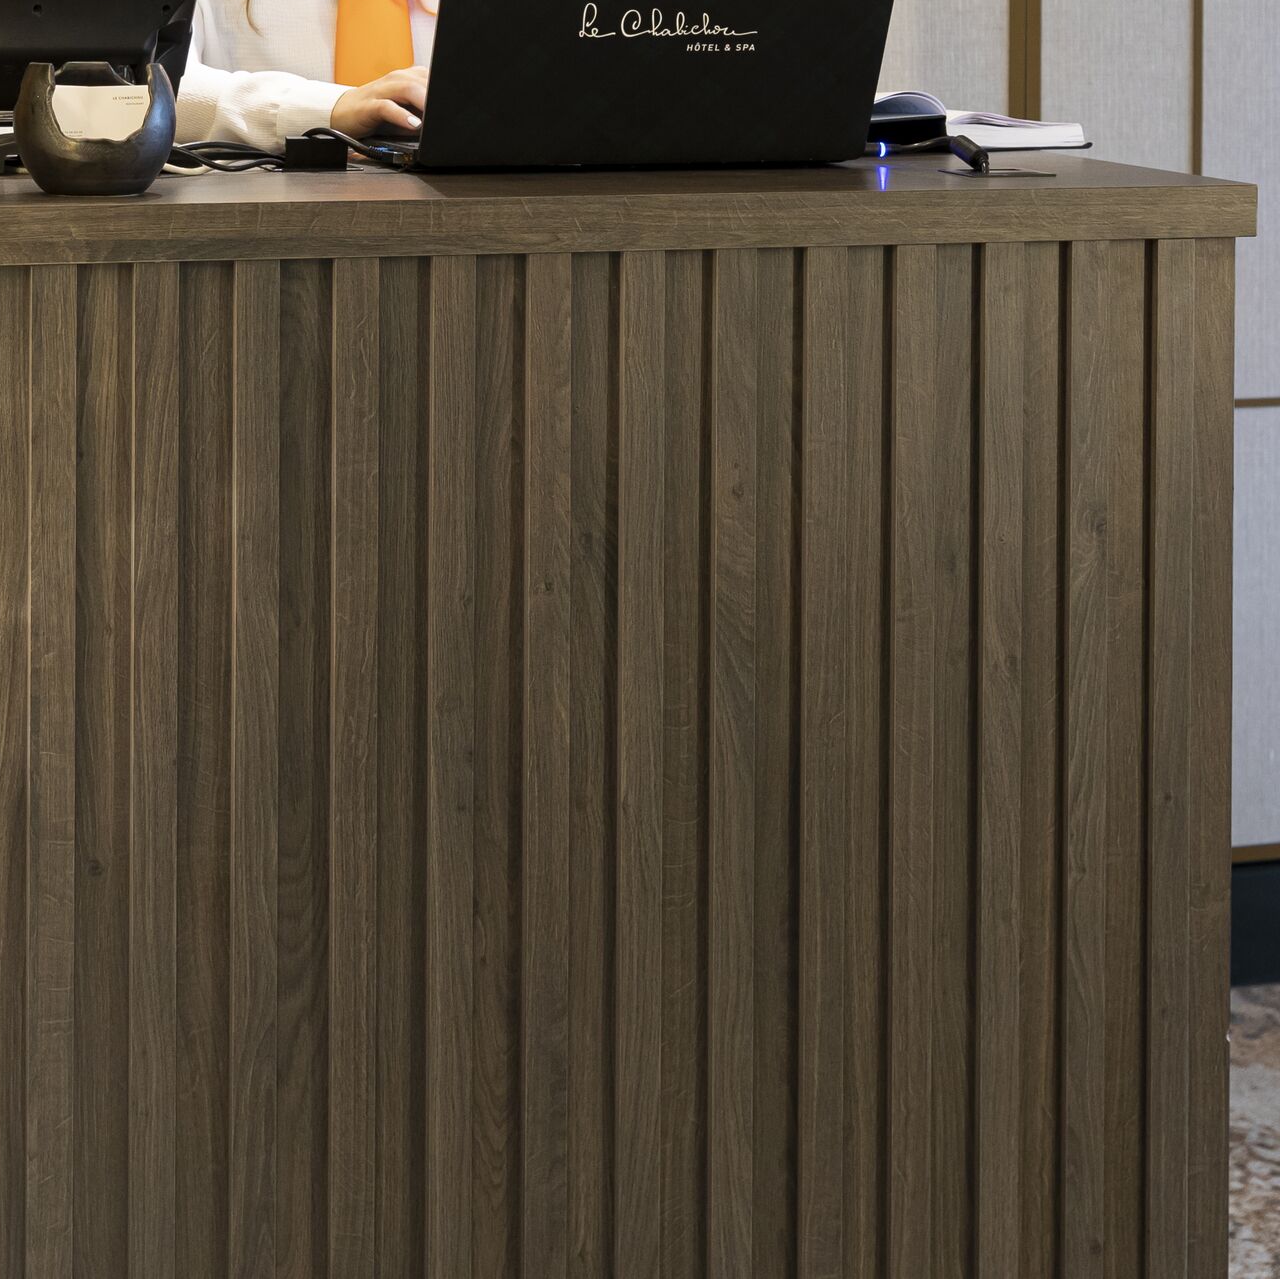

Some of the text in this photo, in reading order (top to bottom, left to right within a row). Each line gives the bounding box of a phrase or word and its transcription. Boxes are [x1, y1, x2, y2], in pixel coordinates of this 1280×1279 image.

[578, 2, 758, 38] Le Chabichou
[686, 42, 756, 52] HÔTEL & SPA
